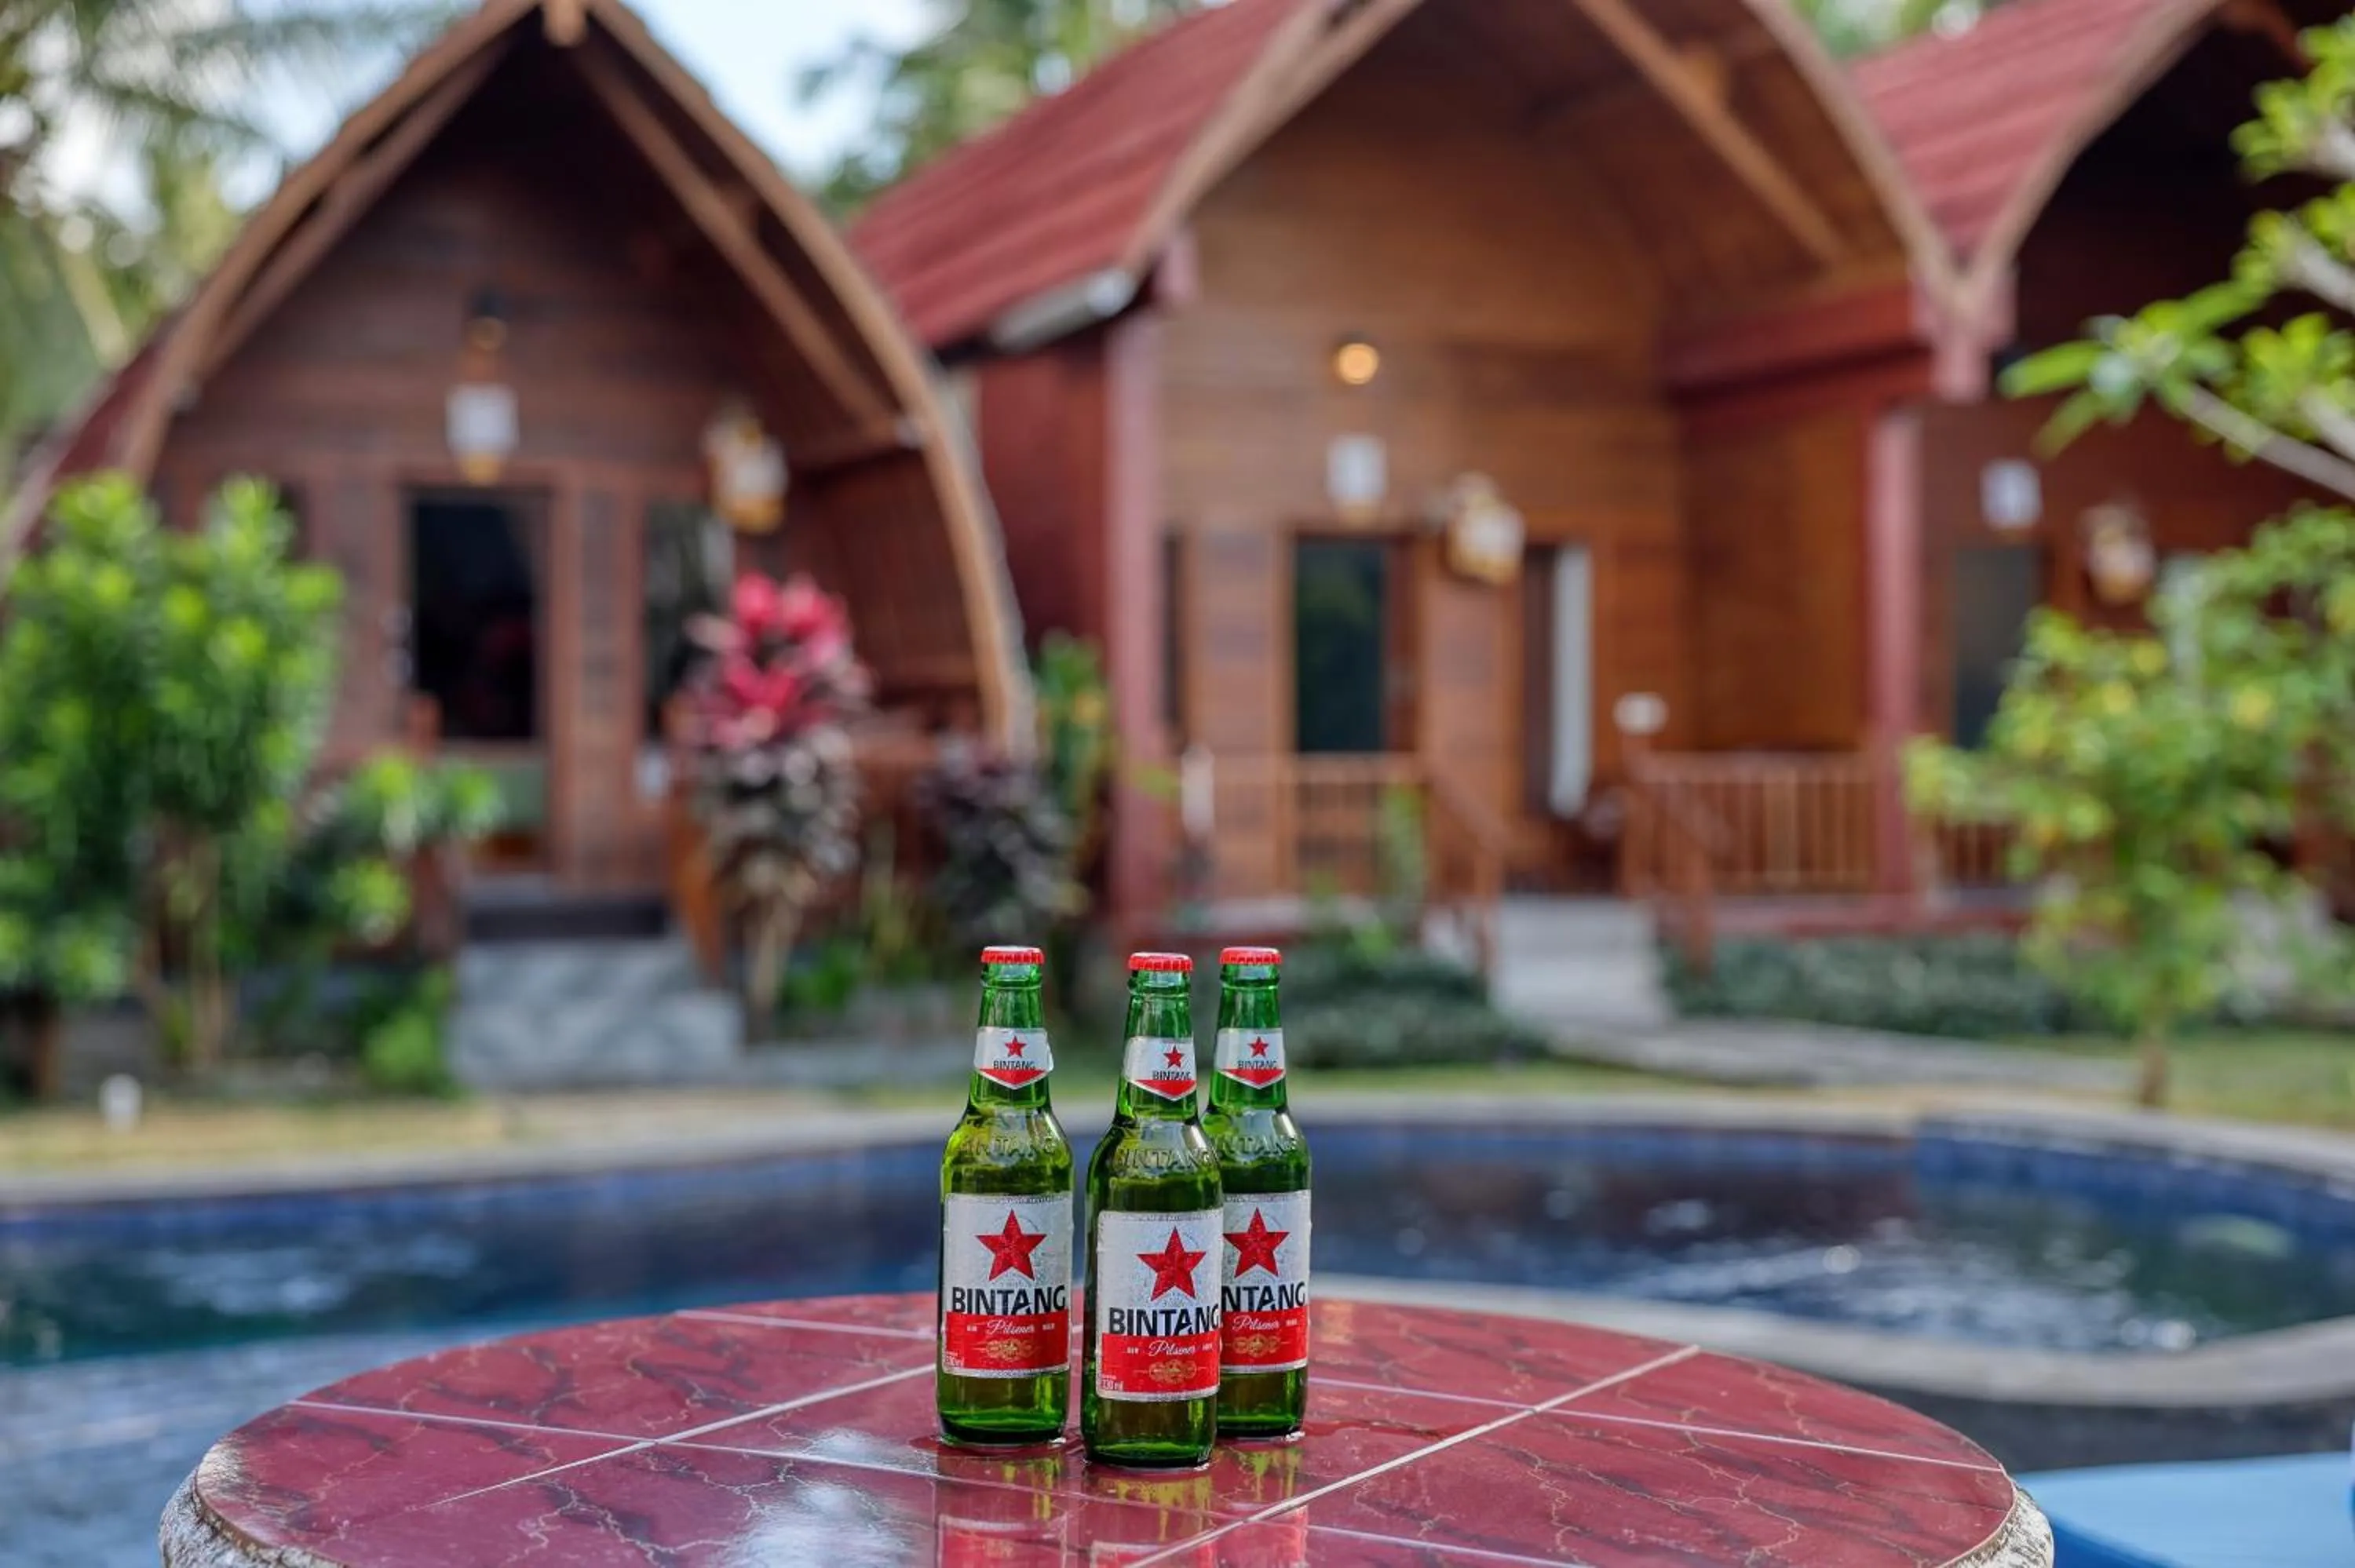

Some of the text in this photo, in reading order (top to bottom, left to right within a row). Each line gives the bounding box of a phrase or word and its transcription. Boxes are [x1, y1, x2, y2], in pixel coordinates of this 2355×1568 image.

[993, 1060, 1035, 1070] BINTANG
[952, 1285, 1065, 1315] BINTANG
[1221, 1282, 1305, 1311] NTANG
[1109, 1304, 1219, 1336] BINTANG
